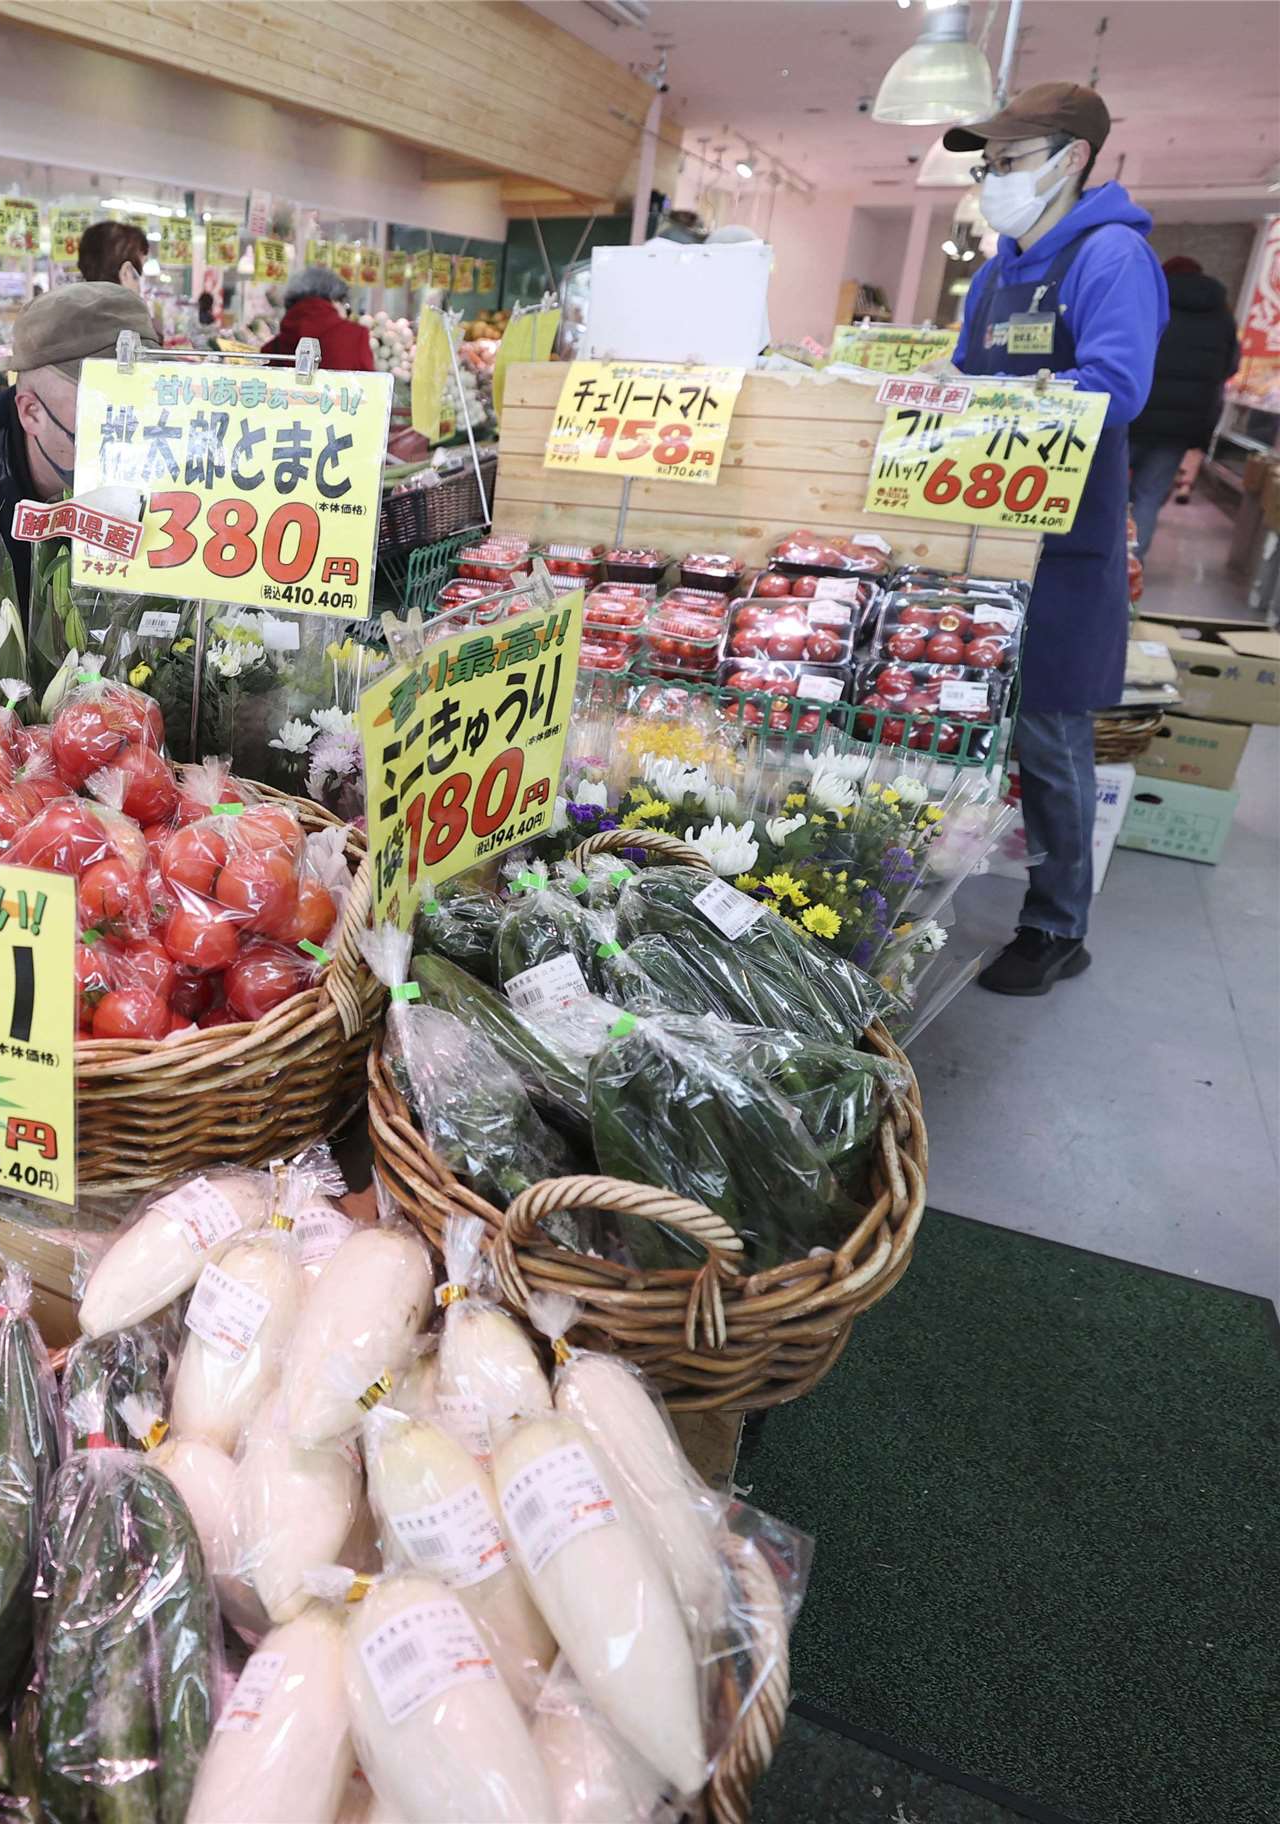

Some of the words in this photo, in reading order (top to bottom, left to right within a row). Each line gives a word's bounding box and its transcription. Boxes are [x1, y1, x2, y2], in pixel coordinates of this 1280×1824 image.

[574, 379, 718, 420] チェリートマト
[896, 410, 1086, 465] フルーツトマト
[21, 510, 135, 554] 静岡県産
[81, 559, 130, 578] アキダイ
